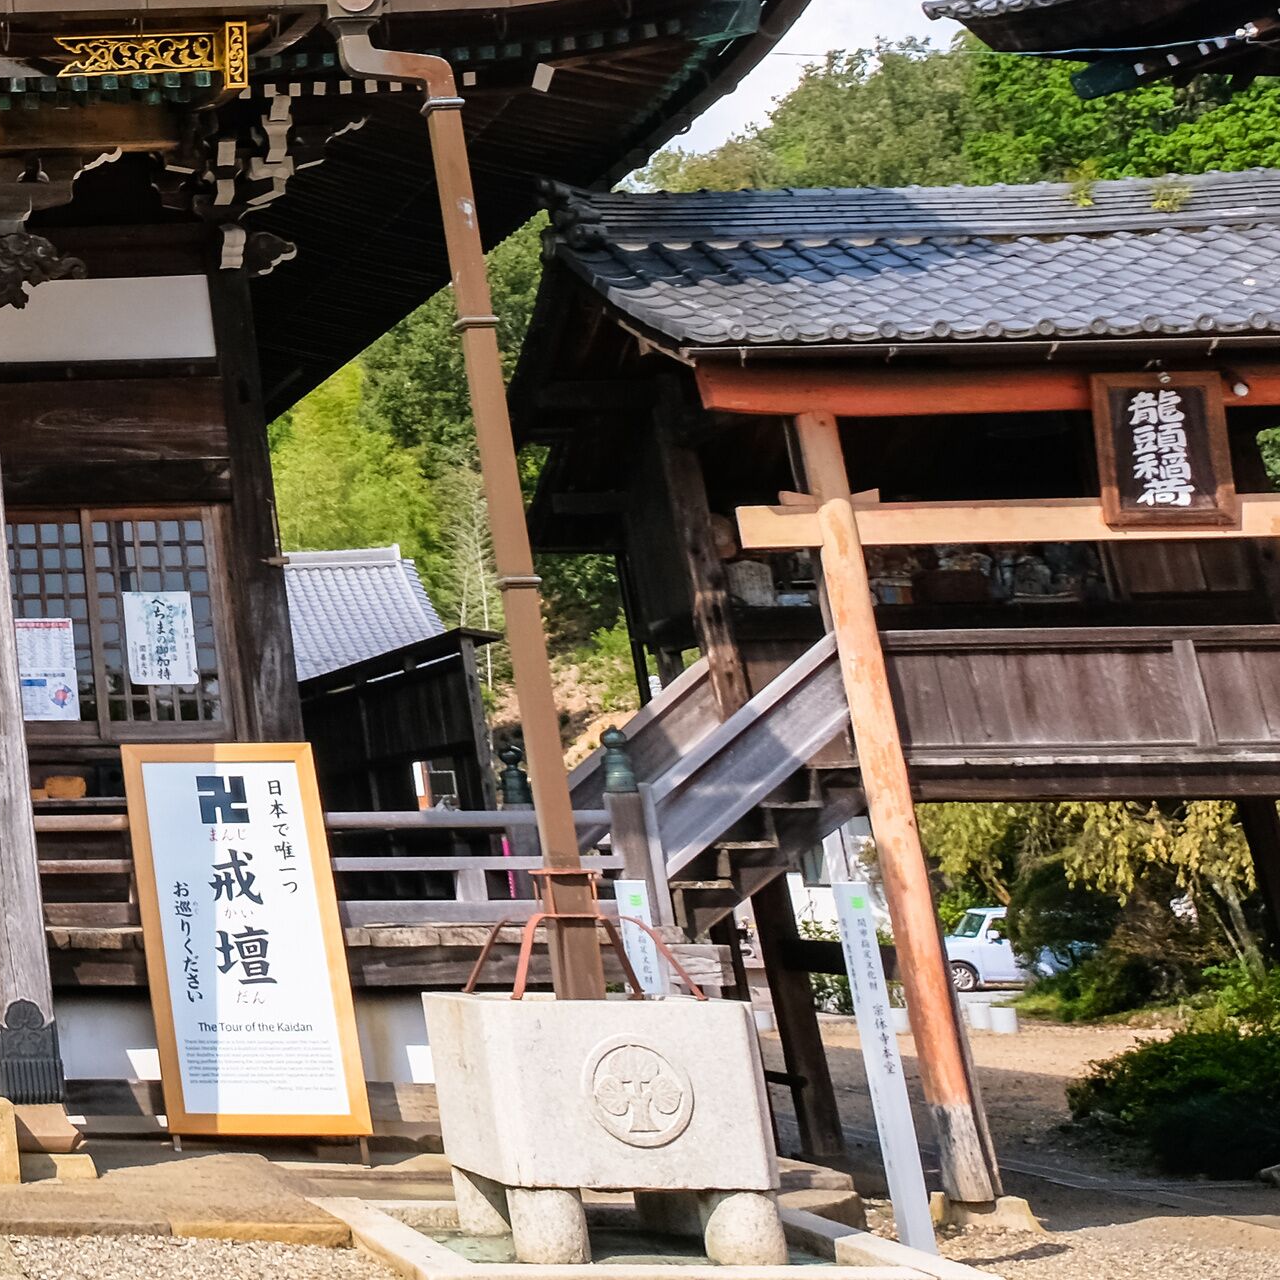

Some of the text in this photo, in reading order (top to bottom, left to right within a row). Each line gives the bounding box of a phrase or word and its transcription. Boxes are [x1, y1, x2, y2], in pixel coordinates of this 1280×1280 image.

[1127, 389, 1195, 507] 龍頭稲荷
[151, 599, 171, 680] へちまの御加持
[267, 779, 298, 894] 日本で唯一つ
[173, 881, 203, 1002] お巡りください
[198, 1022, 313, 1032] The Tour of the Kaidan
